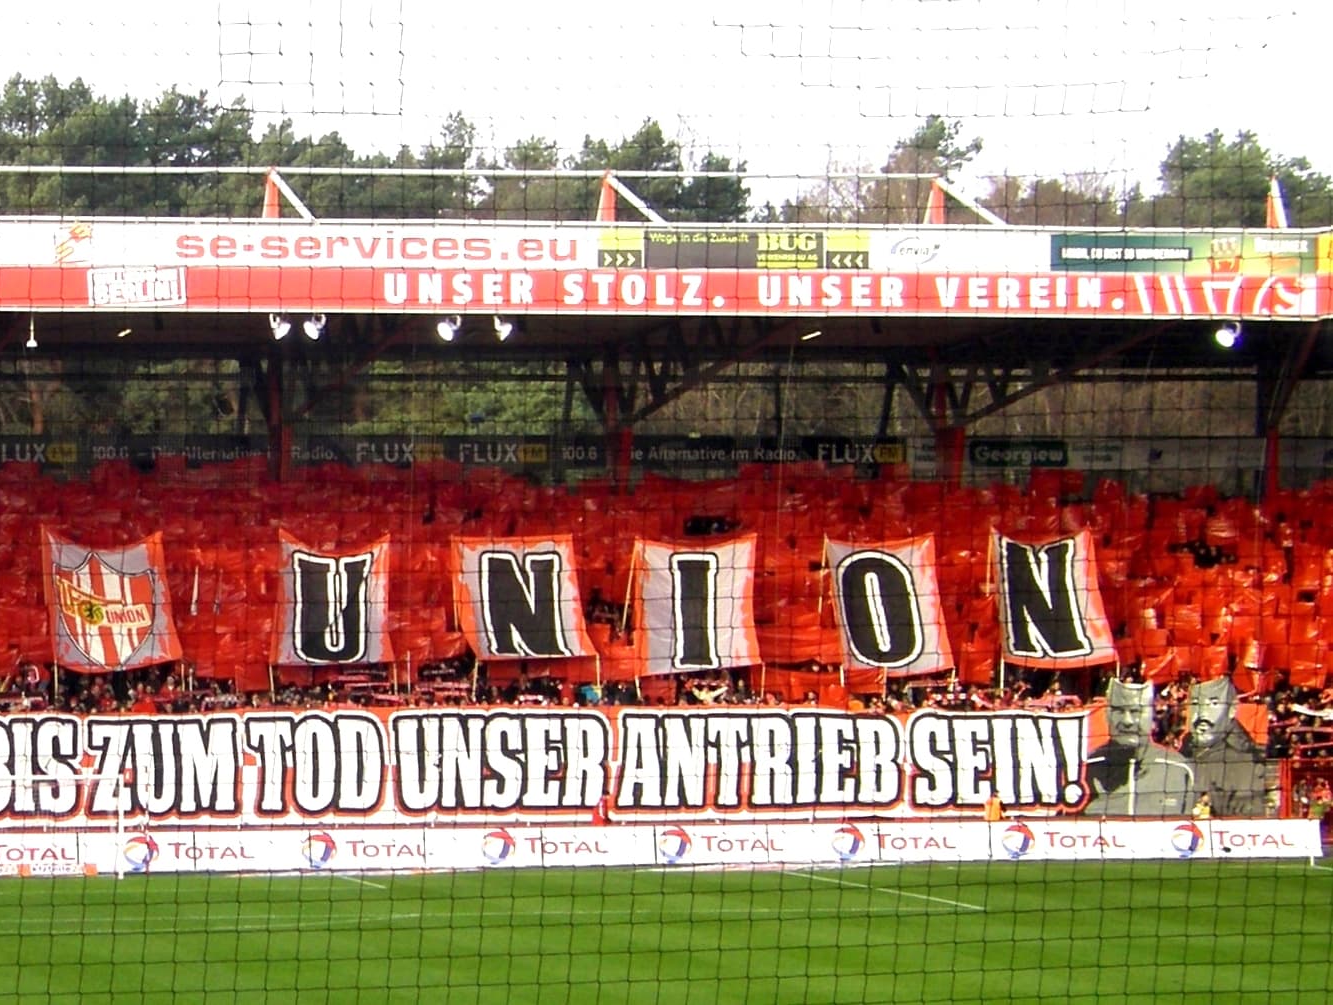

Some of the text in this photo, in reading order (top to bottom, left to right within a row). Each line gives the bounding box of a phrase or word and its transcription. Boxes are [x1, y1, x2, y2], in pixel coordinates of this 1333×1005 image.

[176, 229, 578, 261] se-services.eu
[710, 233, 749, 243] Zukunft
[757, 233, 817, 251] BUG
[383, 273, 1124, 311] UNSER STOLZ. UNSER VEREIN.
[105, 606, 147, 625] UNION
[86, 718, 238, 816] ZUM
[246, 715, 384, 812] TOD
[393, 714, 610, 810] UNSER
[615, 713, 903, 809] ANTRIEB
[910, 711, 1087, 808] SEIN!
[524, 837, 609, 855] TOTAL
[701, 835, 784, 852] TOTAL
[878, 833, 957, 850] TOTAL
[1043, 831, 1126, 849] TOTAL
[1214, 830, 1295, 847] TOTAL
[168, 842, 254, 860] TOTAL
[346, 840, 429, 858] TOTAL
